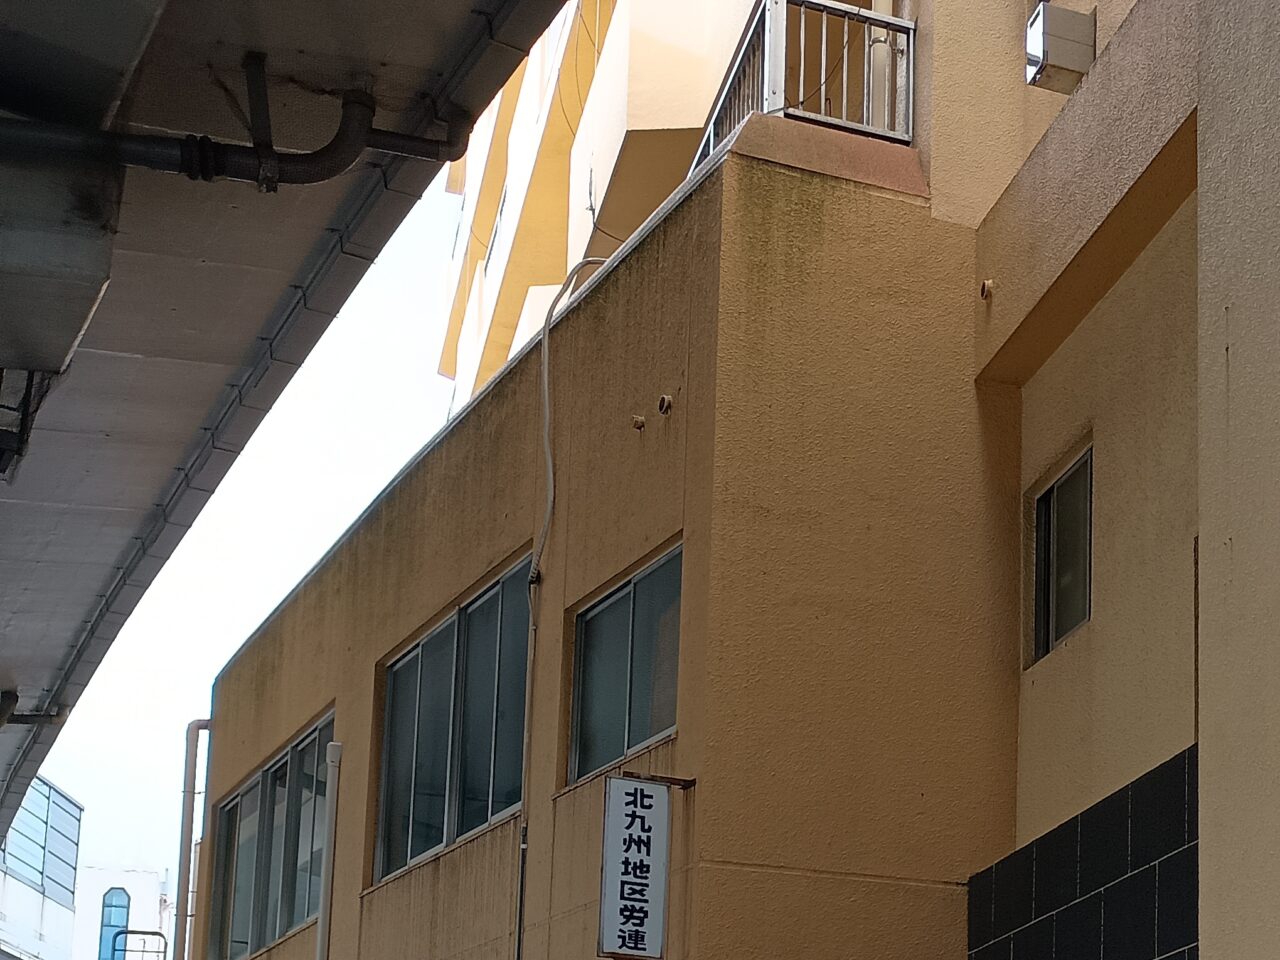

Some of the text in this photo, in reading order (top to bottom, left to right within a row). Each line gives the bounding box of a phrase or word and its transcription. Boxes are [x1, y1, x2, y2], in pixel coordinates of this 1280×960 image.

[617, 787, 654, 952] 北九州地区労連
